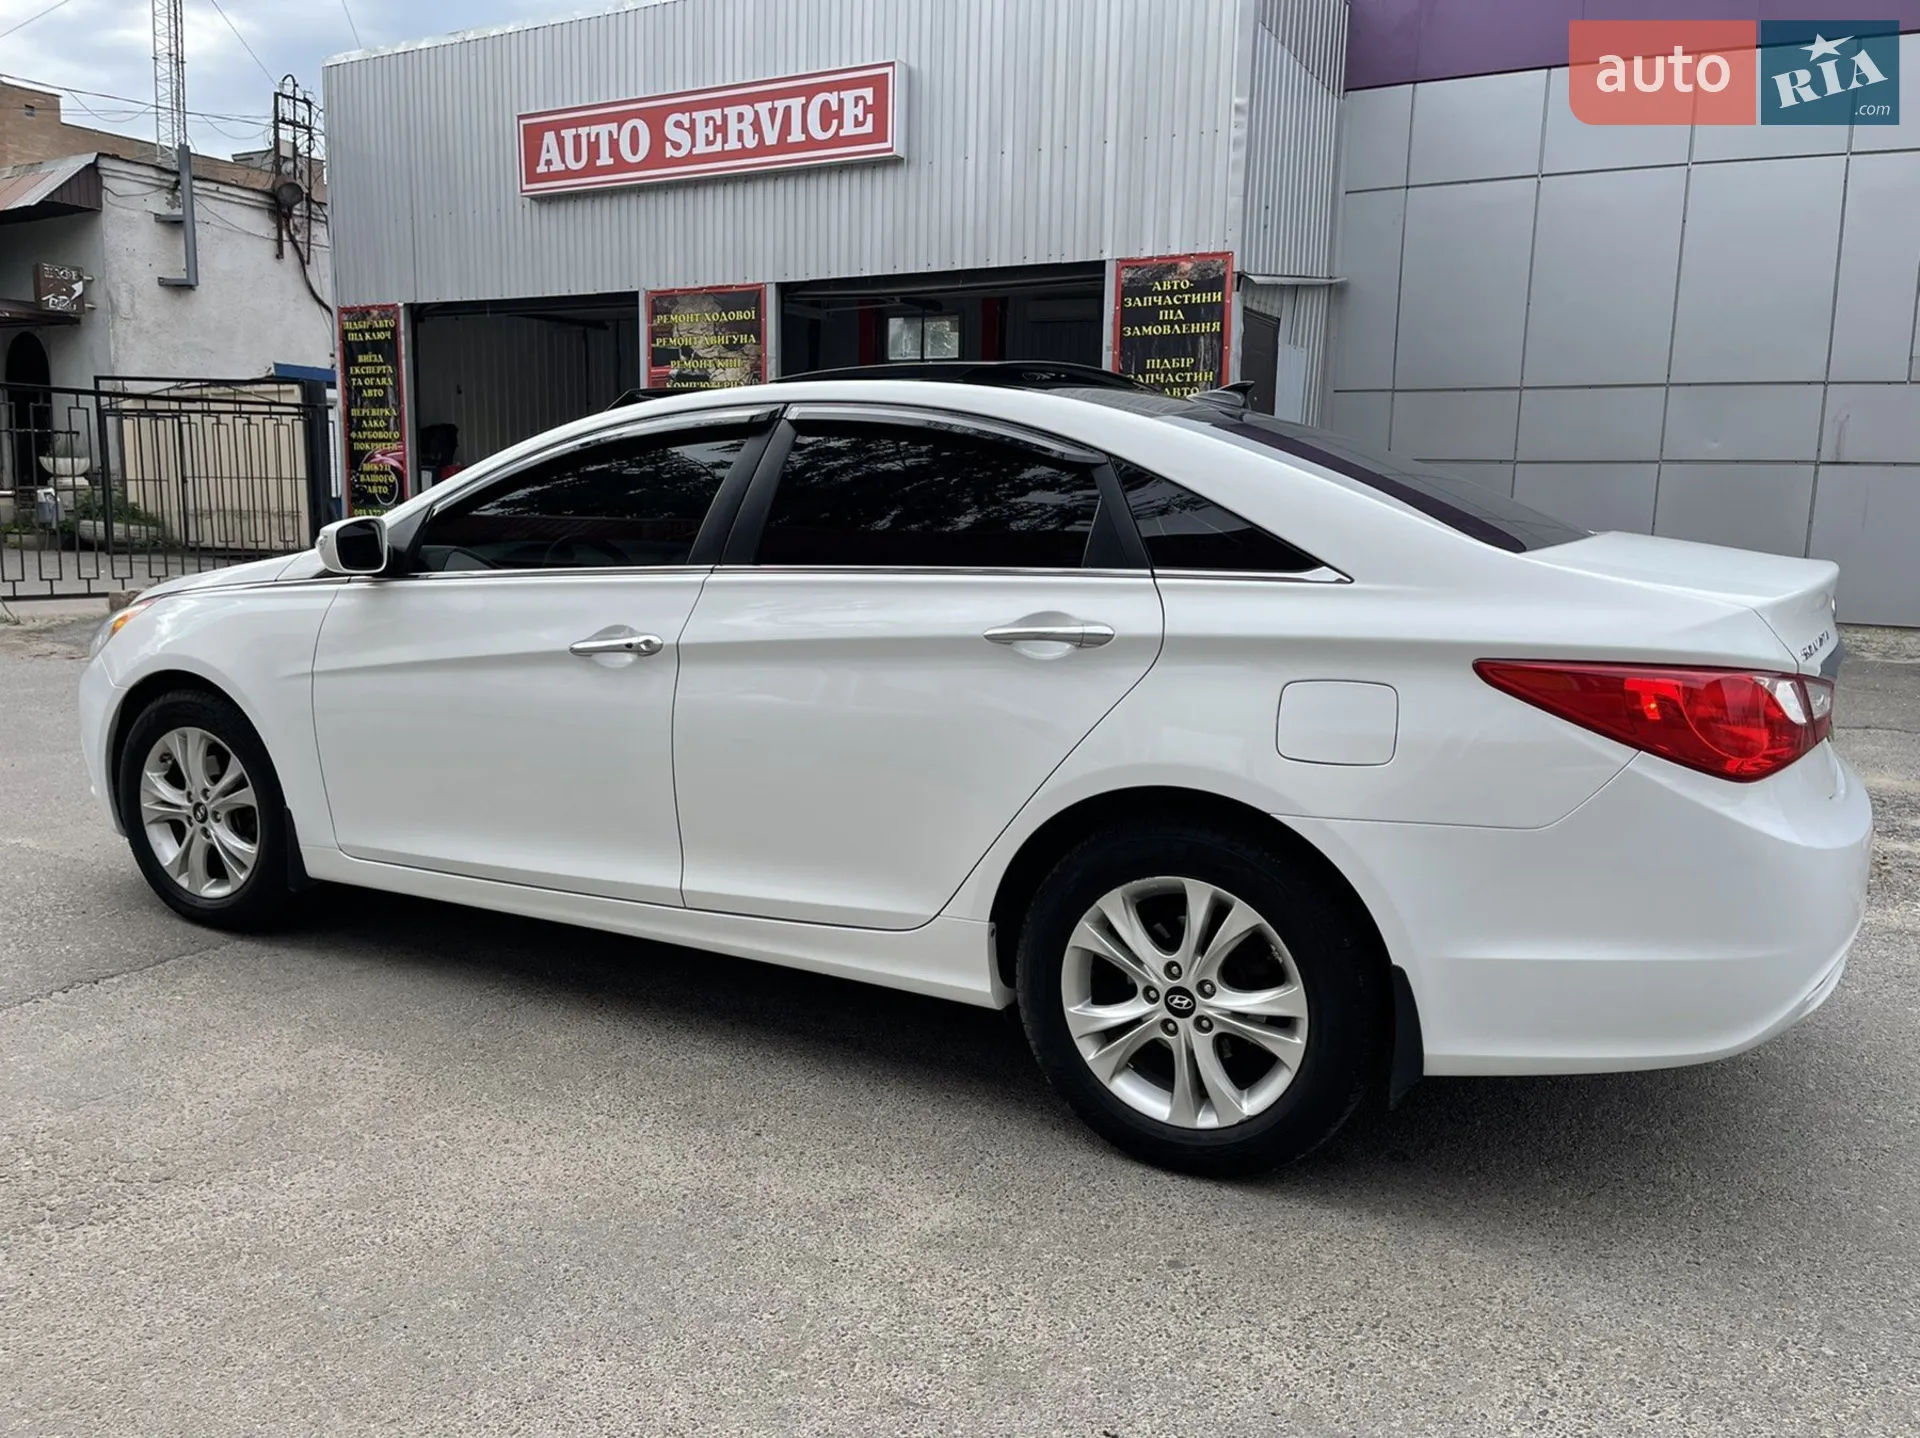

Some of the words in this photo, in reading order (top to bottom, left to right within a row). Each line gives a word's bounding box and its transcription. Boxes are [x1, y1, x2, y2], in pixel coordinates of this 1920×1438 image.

[536, 117, 651, 174] AUTO
[664, 87, 874, 158] SERVICE
[1152, 279, 1194, 291] АВТО-
[1123, 291, 1222, 308] ЗАПЧАСТИНИ
[656, 313, 701, 324] РЕМОНТ
[704, 307, 756, 321] ХОДОВОЇ
[1159, 309, 1185, 320] ПІД
[372, 319, 396, 328] АВТО
[1123, 321, 1221, 337] ЗАМОВЛЕННЯ
[347, 332, 364, 341] ПІД
[364, 331, 392, 341] КЛЮЧ
[655, 336, 699, 347] РЕМОНТ
[704, 333, 757, 346] ДВИГУНА
[670, 359, 714, 369] РЕМОНТ
[1146, 357, 1195, 370] ПІДБІР
[349, 365, 393, 375] ЕКСПЕРТА
[351, 377, 363, 386] ТА
[362, 388, 384, 397] АВТО
[351, 407, 397, 416] ПЕРЕВІРКА
[350, 430, 400, 440] ФАРБОВОГО
[360, 474, 395, 483] ВАШОГО
[367, 485, 388, 494] АВТО
